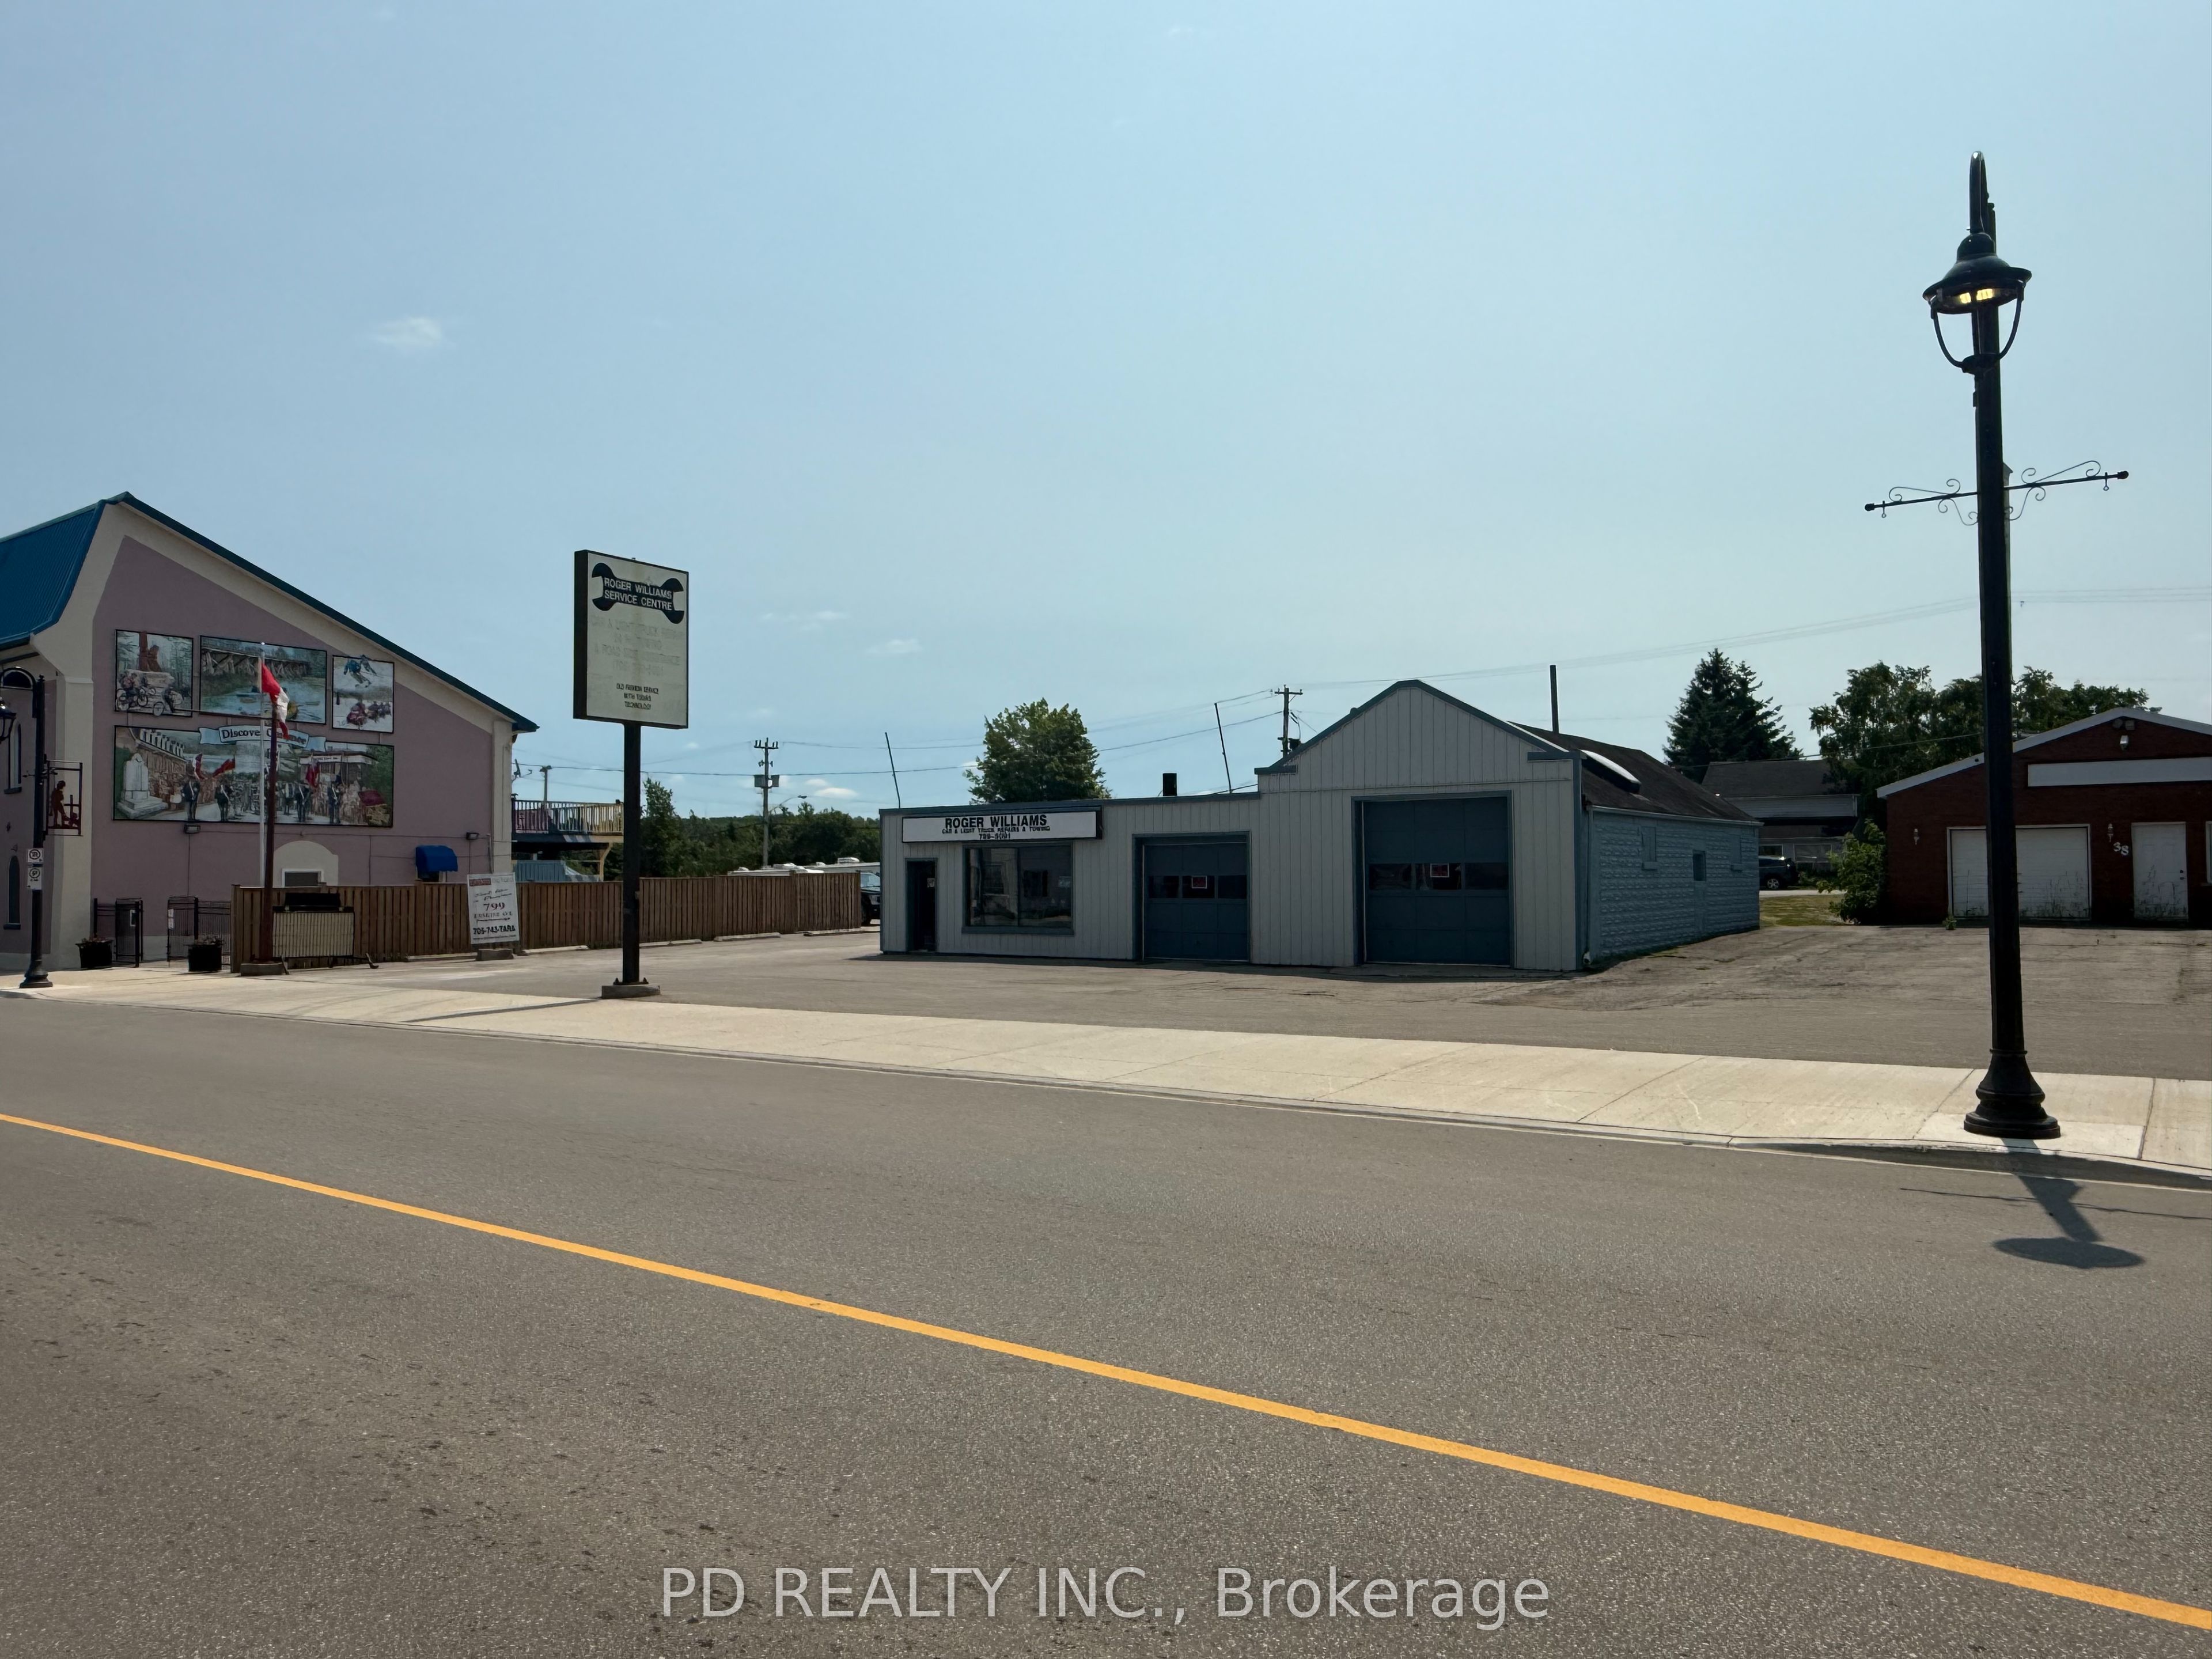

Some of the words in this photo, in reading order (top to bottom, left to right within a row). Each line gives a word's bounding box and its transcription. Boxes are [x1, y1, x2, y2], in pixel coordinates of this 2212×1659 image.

[604, 577, 632, 591] ROGER
[635, 584, 672, 599] WILLIAMS
[604, 590, 638, 604] SERVICE
[641, 597, 672, 611] CENTRE
[945, 817, 984, 828] ROGER
[990, 815, 1047, 827] WILLIAMS
